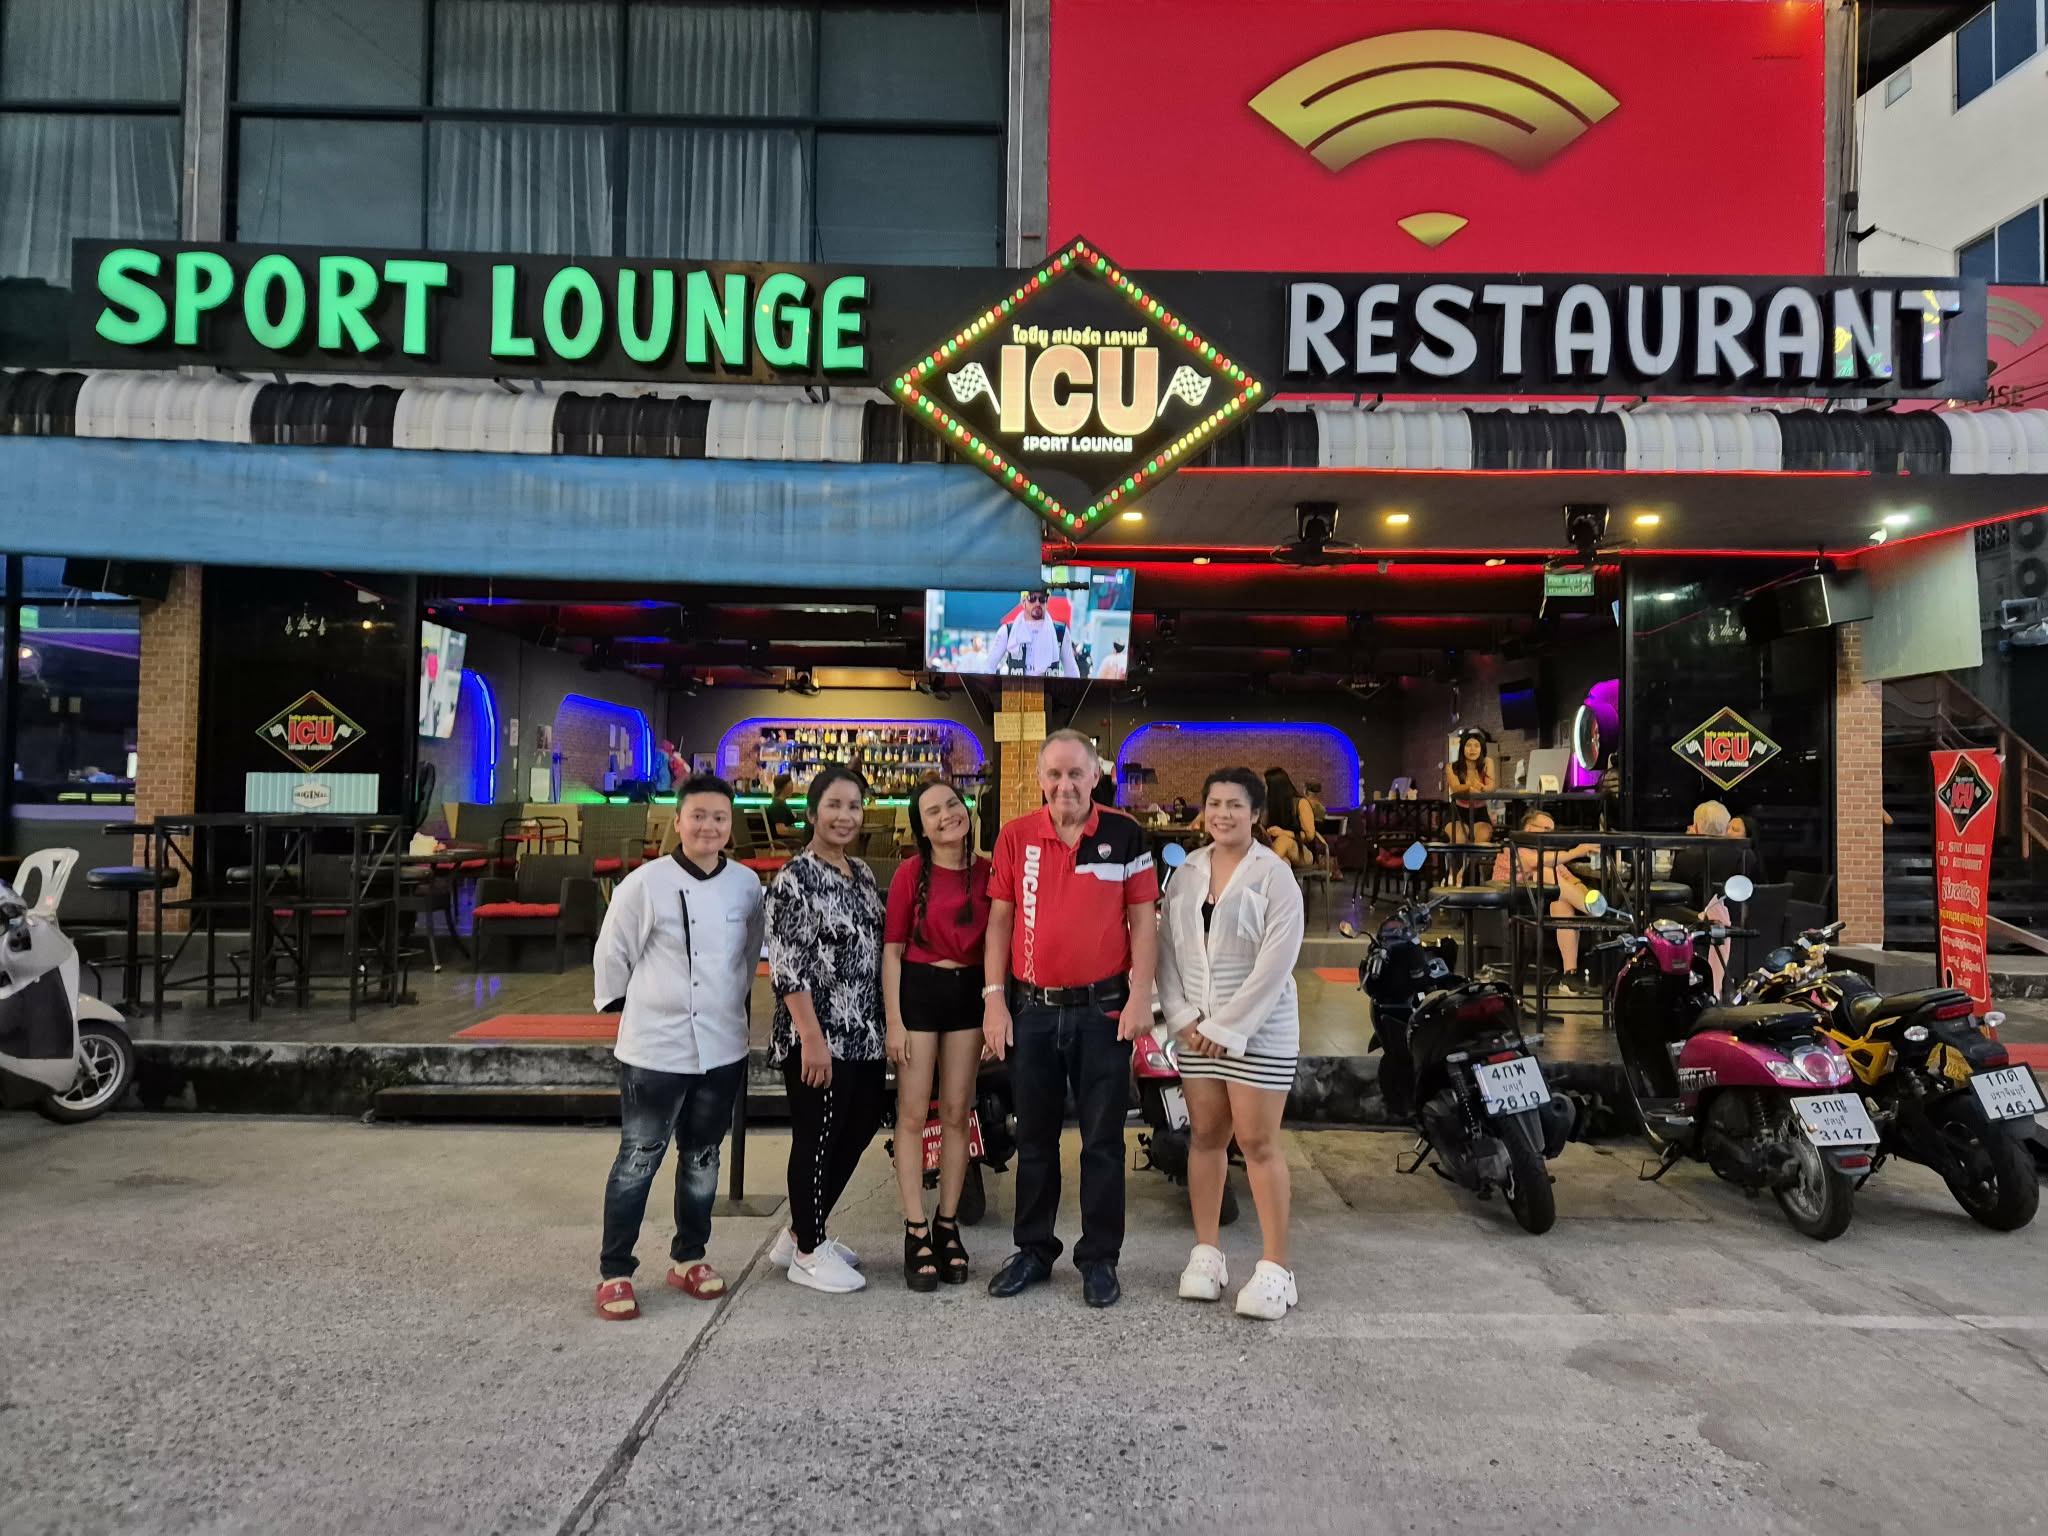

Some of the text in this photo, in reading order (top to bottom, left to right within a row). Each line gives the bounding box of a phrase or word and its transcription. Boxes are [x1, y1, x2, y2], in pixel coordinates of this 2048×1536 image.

[96, 248, 866, 369] SPORT LOUNGE
[1286, 281, 1961, 381] RESTAURANT
[1000, 344, 1159, 436] ICU
[1023, 435, 1133, 452] SPORT LOUNGE
[287, 720, 335, 745] ICU
[1704, 736, 1750, 762] ICU
[1023, 844, 1041, 929] DUCATI
[1495, 1090, 1541, 1112] 2619
[1994, 1098, 2037, 1118] 1461
[1819, 1127, 1862, 1141] 3147
